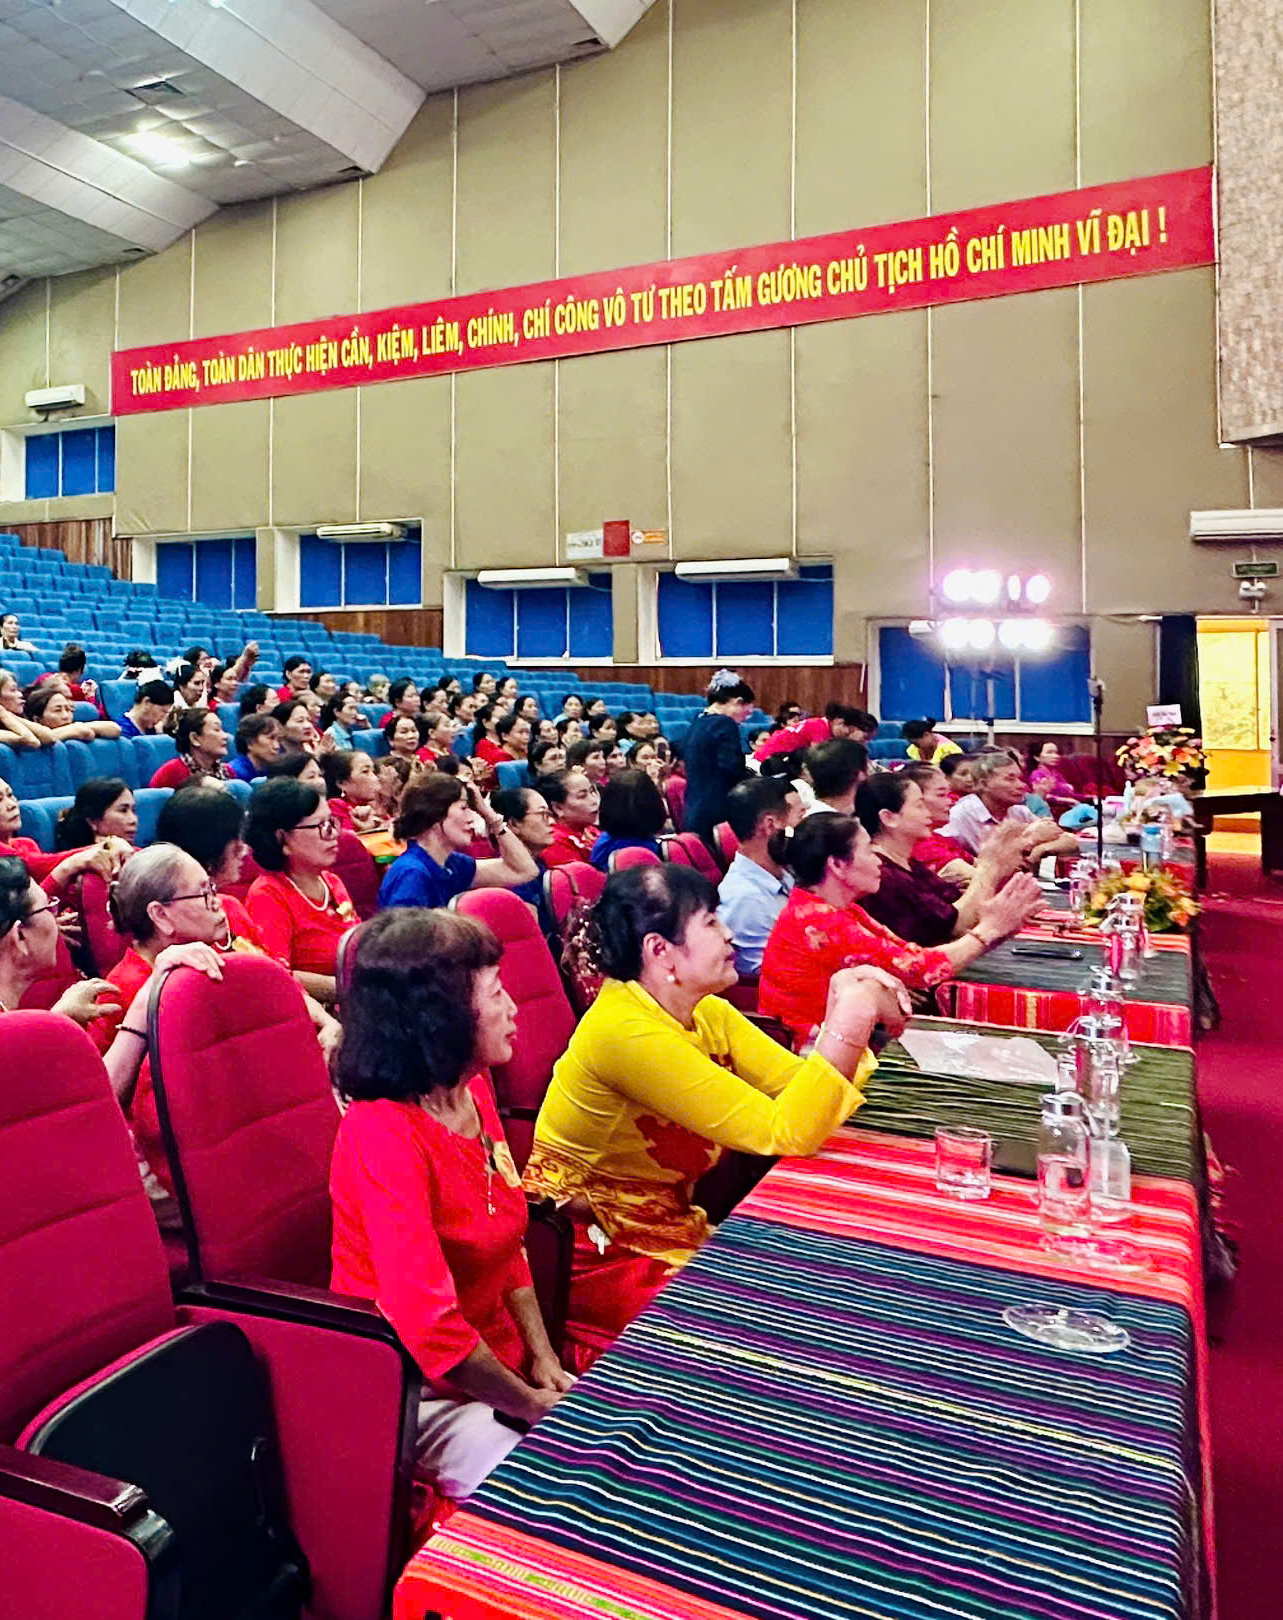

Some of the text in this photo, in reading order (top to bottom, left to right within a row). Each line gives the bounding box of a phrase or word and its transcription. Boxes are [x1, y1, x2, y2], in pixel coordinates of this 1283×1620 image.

[131, 206, 1167, 395] TOÀN ĐẢNG, TOÀN DÂN THỰC HIỆN CẦN, KIỆM, LIÊM, CHÍNH, CHÍ CÔNG VÔ TƯ THEO TẤM GƯƠNG CHỦ TỊCH HỒ CHÍ MINH VĨ ĐẠI !
